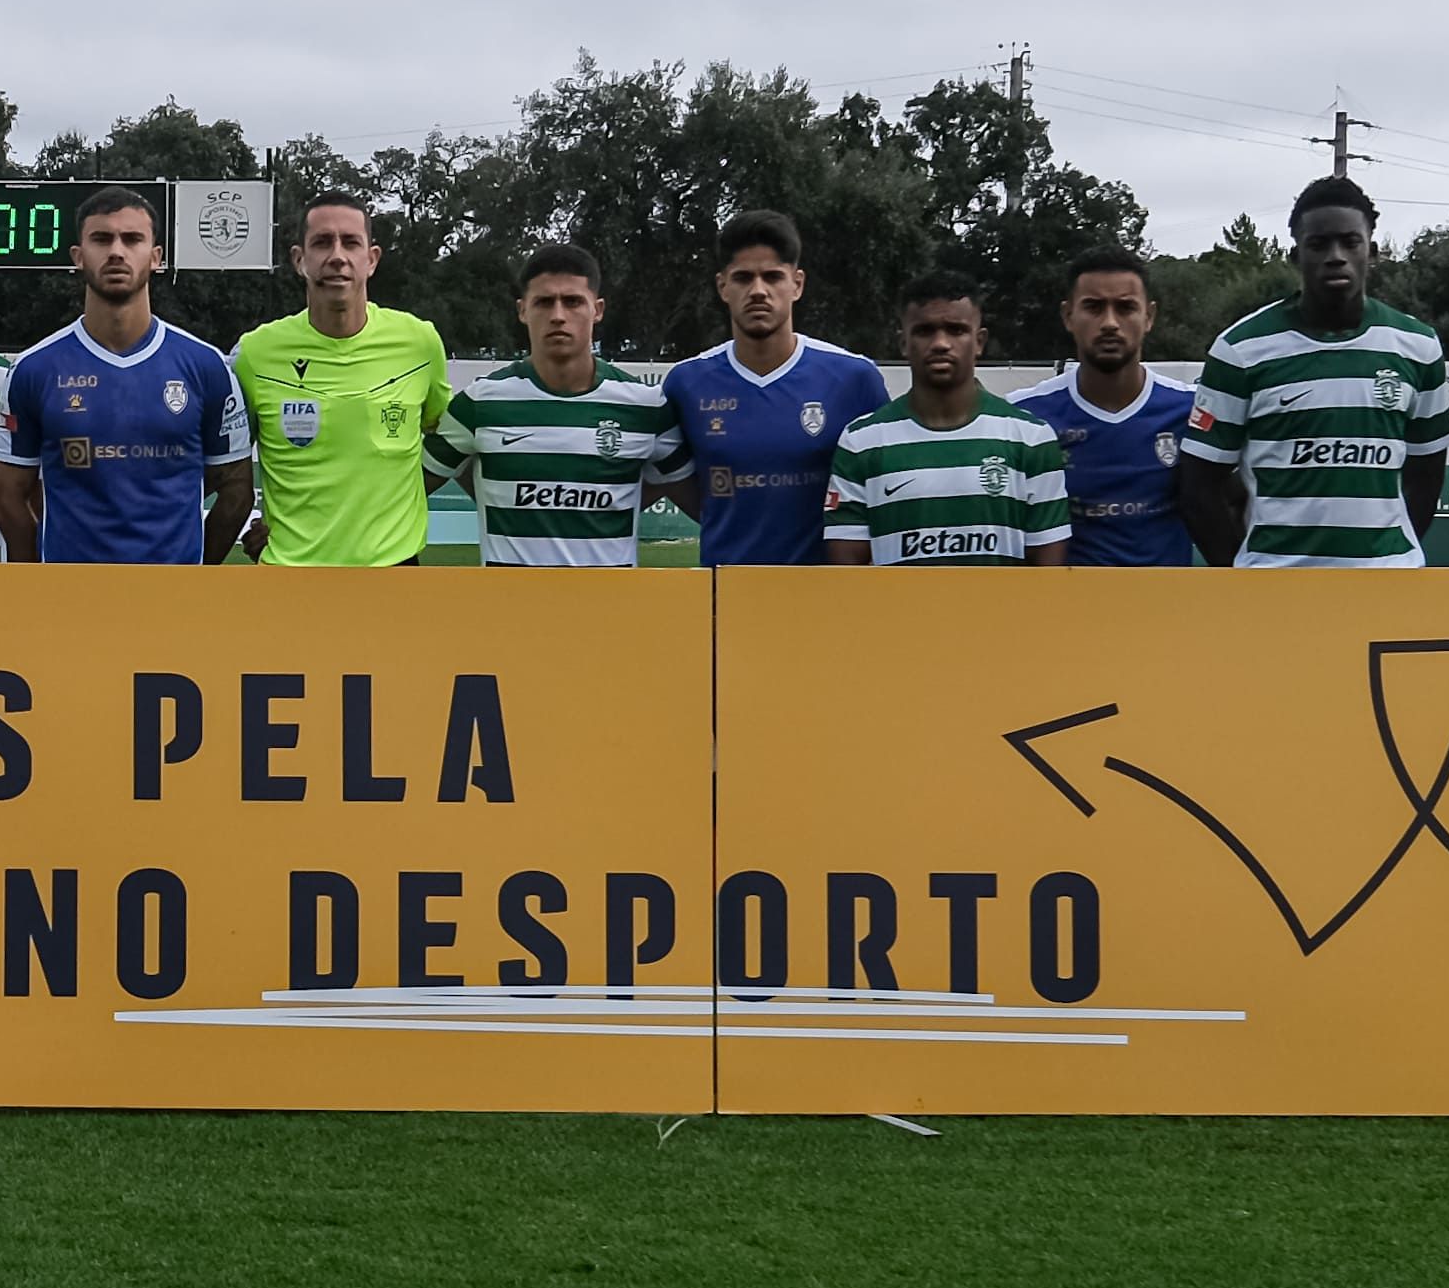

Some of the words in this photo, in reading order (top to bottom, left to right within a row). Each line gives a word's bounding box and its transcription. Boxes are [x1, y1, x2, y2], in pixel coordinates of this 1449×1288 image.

[207, 191, 243, 204] SCP
[57, 375, 98, 389] LAGO
[283, 402, 317, 415] FIFA
[699, 398, 738, 411] LAGO
[94, 446, 127, 459] ESC
[1290, 439, 1392, 465] Betano
[734, 475, 767, 488] ESC
[770, 472, 822, 487] ONLIN
[515, 482, 612, 509] Betano
[901, 530, 998, 558] Betano
[132, 672, 516, 804] PELA
[2, 867, 188, 1000] NO
[287, 868, 1103, 1005] DESPORTO
